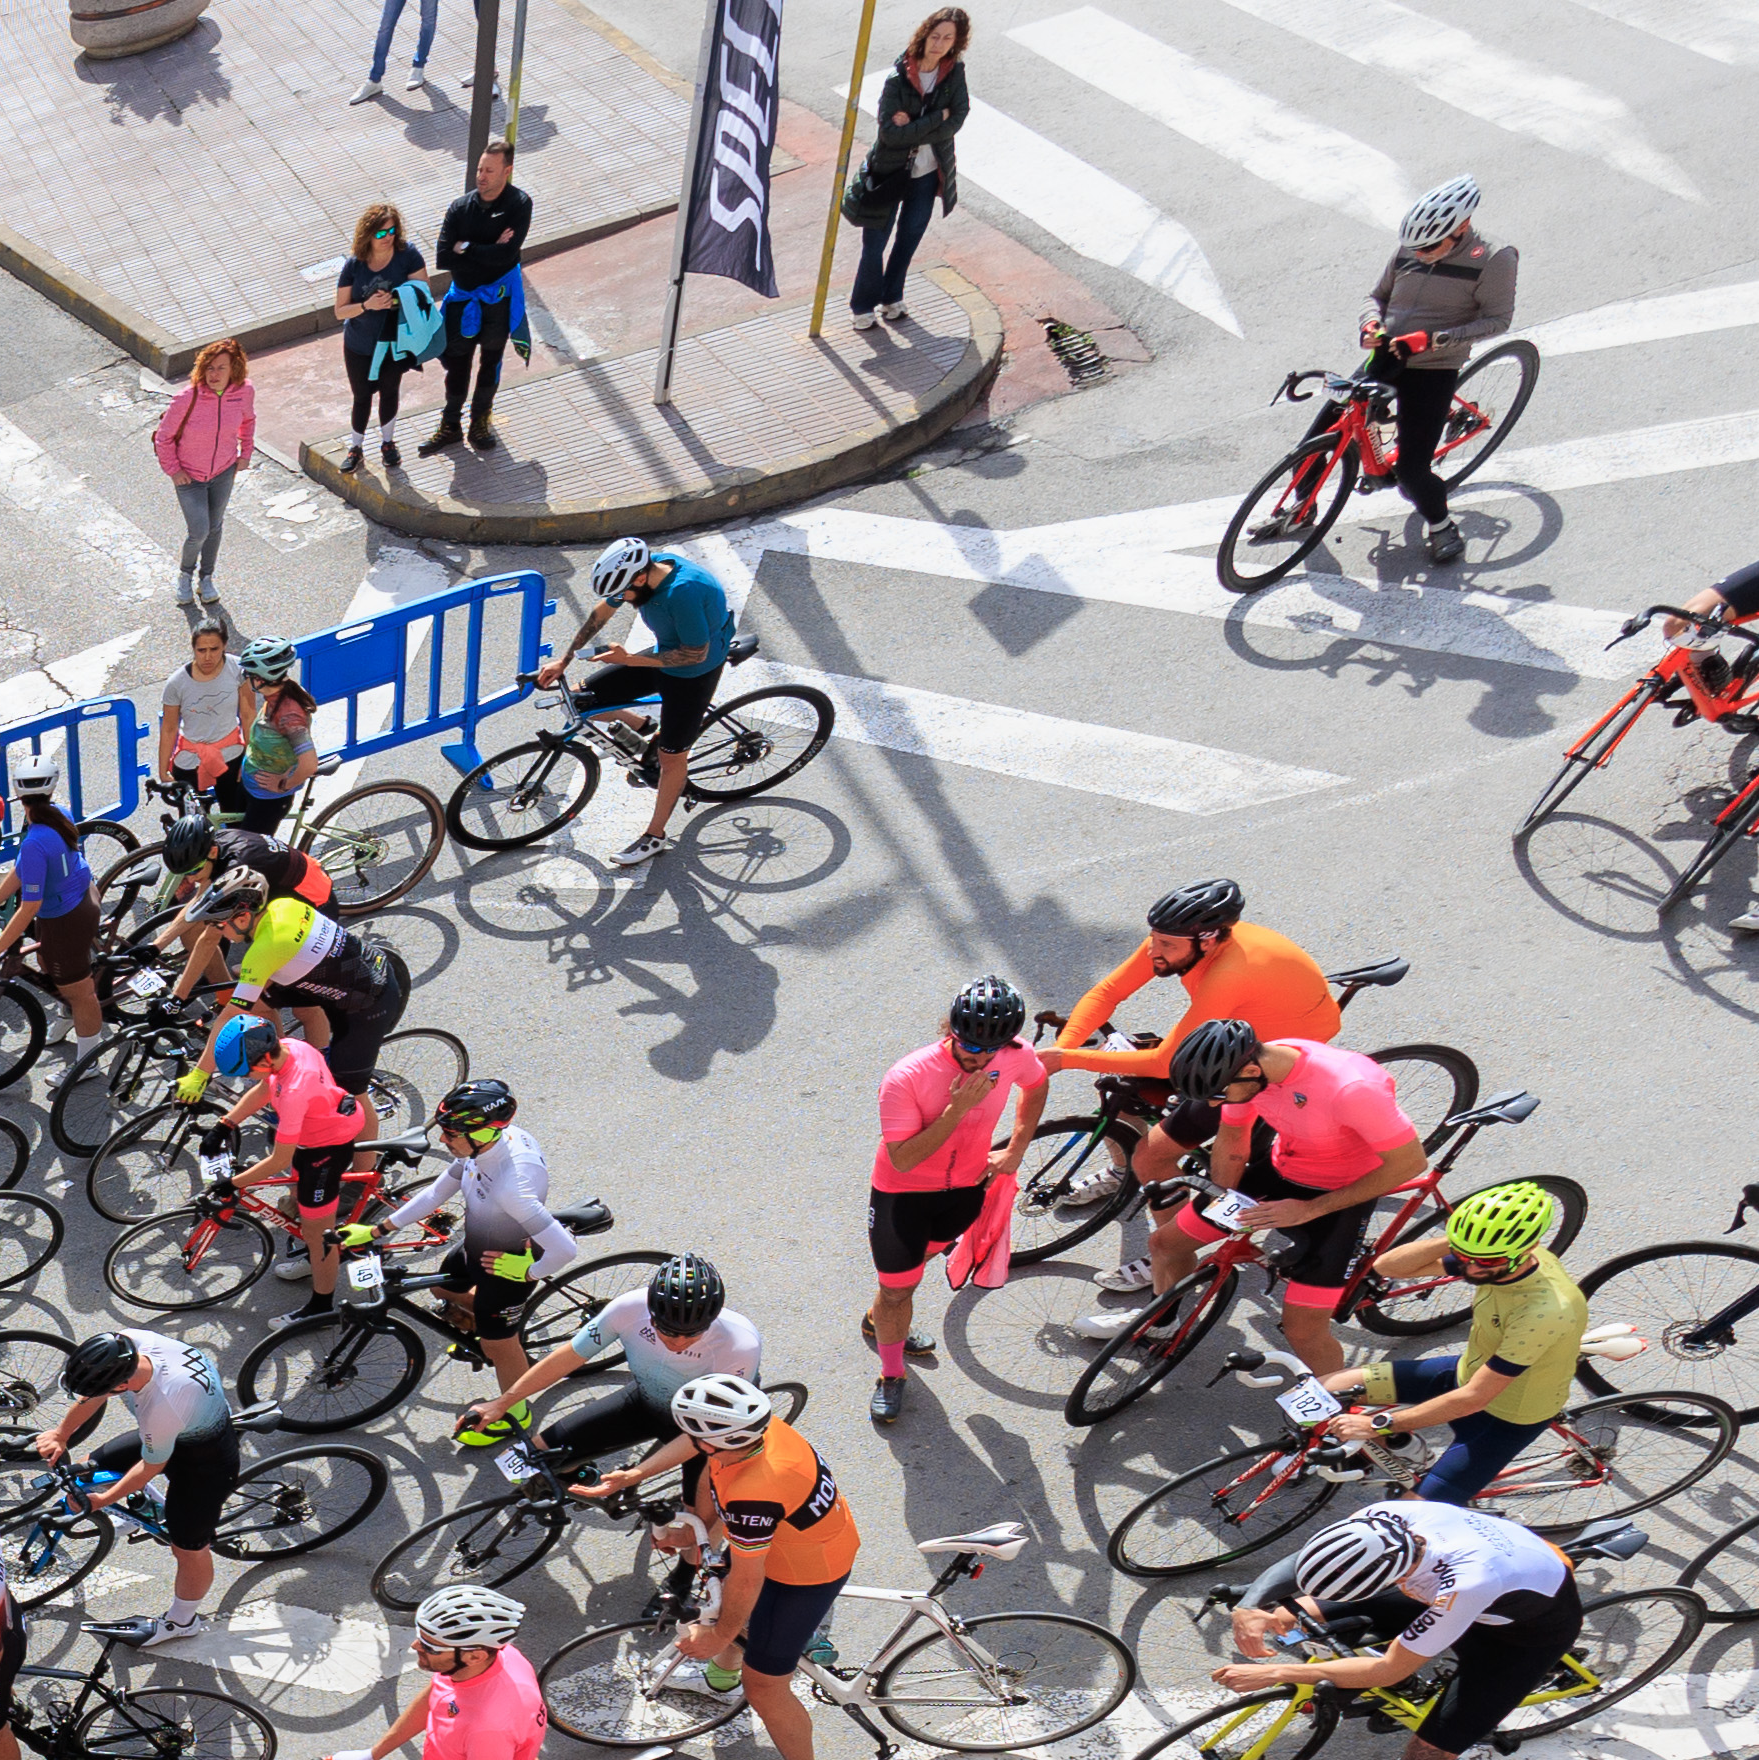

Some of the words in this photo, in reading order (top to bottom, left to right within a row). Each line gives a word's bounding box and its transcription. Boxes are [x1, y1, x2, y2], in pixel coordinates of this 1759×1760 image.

[482, 1096, 507, 1113] KASK
[1291, 1390, 1321, 1418] 182
[504, 1452, 524, 1477] 196
[1402, 1608, 1437, 1640] LORD
